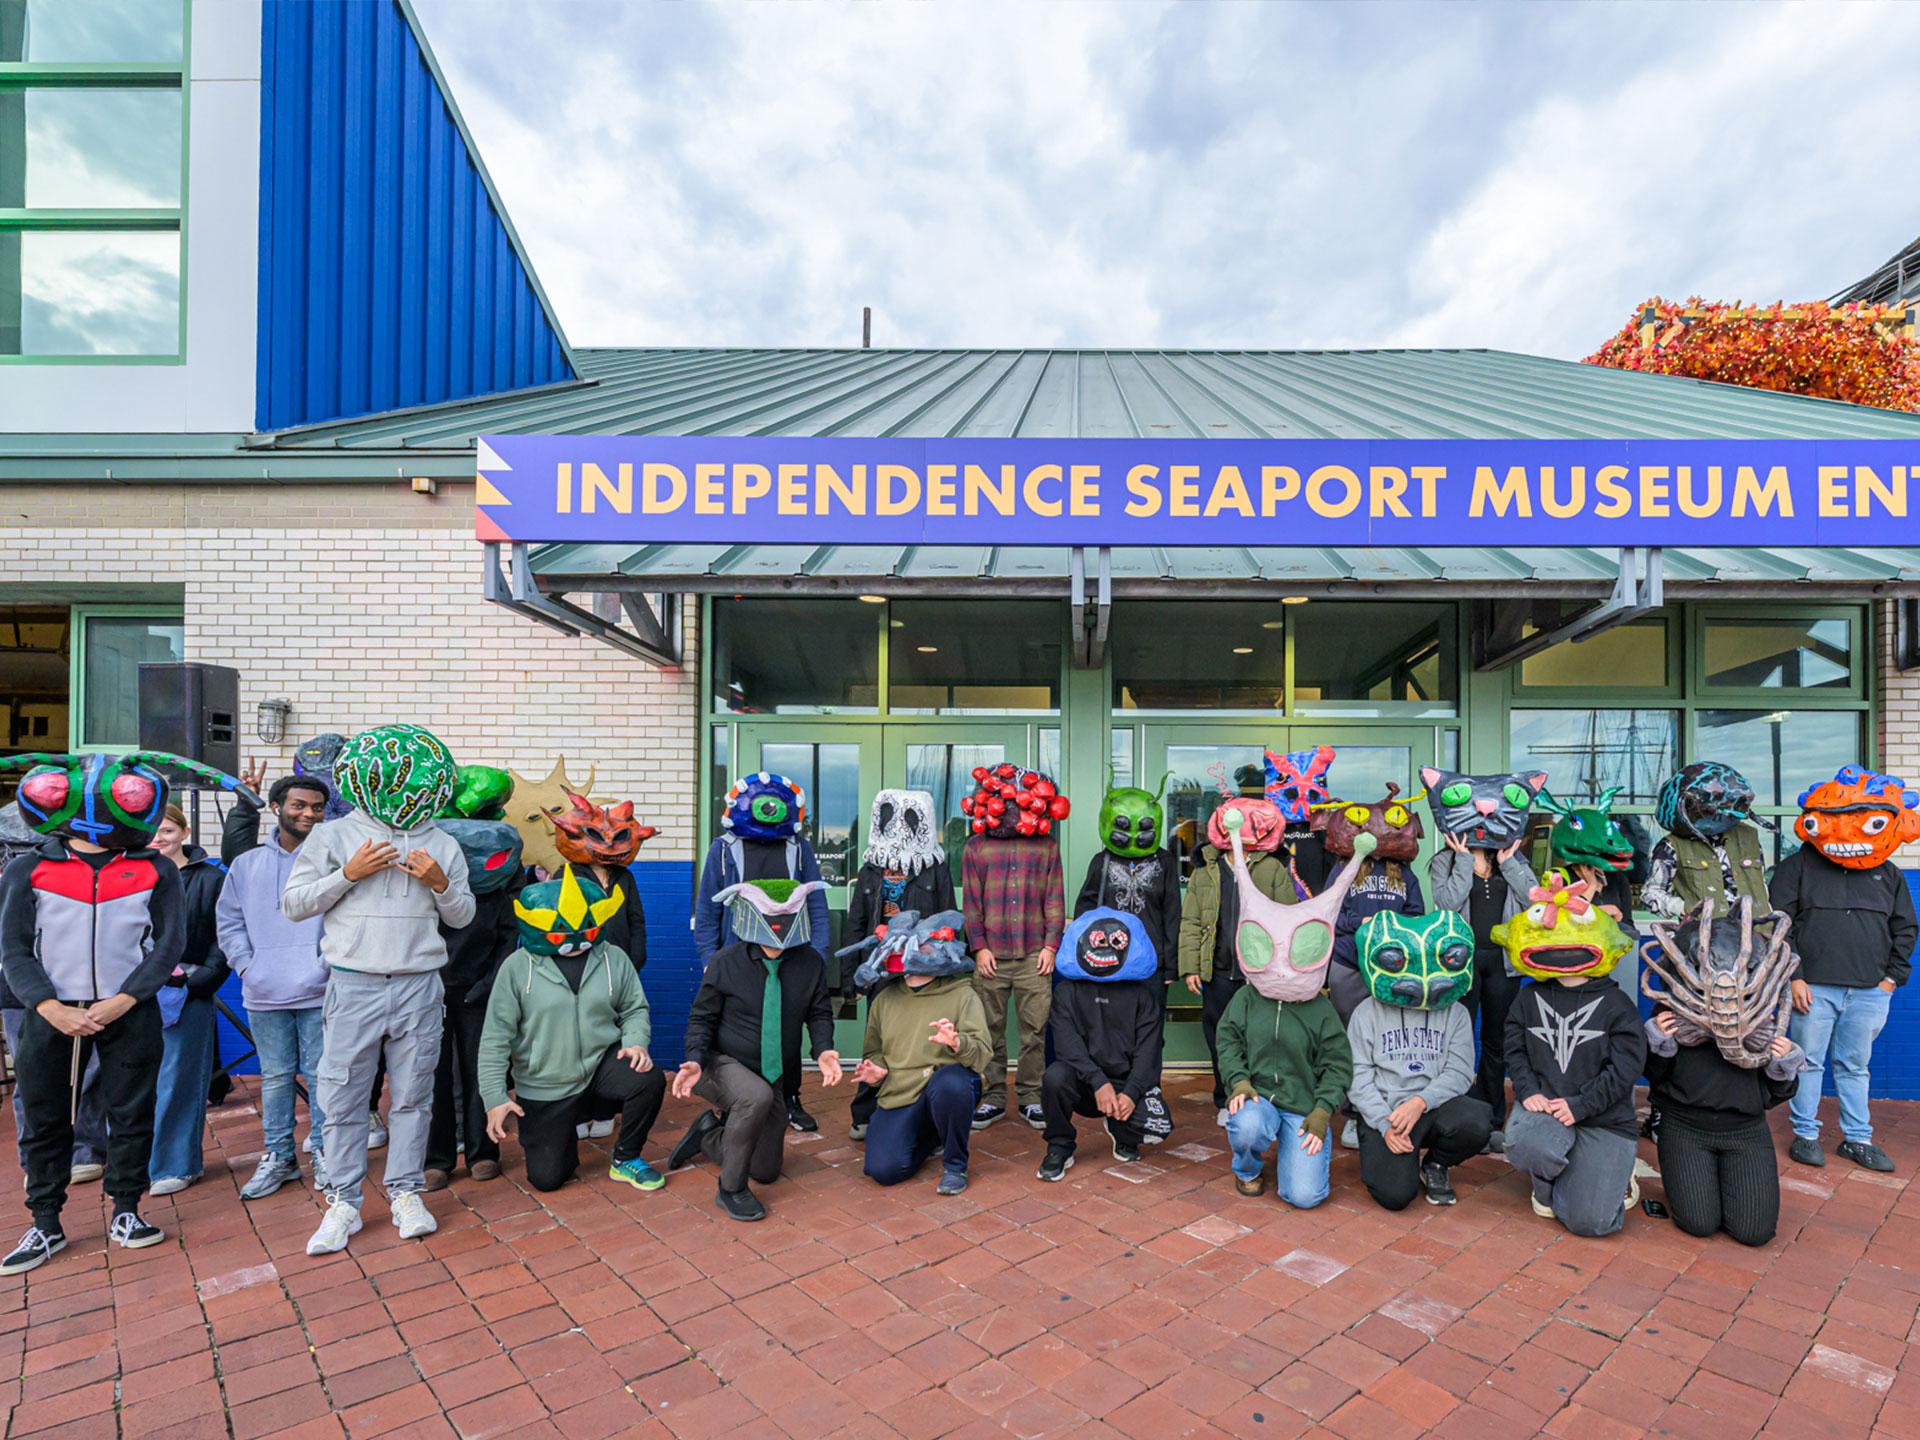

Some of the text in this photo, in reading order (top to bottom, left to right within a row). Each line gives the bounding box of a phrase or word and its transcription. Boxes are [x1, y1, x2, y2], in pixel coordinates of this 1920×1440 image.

[557, 463, 1101, 517] INDEPENDENCE
[1125, 465, 1448, 518] SEAPORT
[1468, 466, 1794, 518] MUSEUM
[1382, 1027, 1410, 1054] PENN
